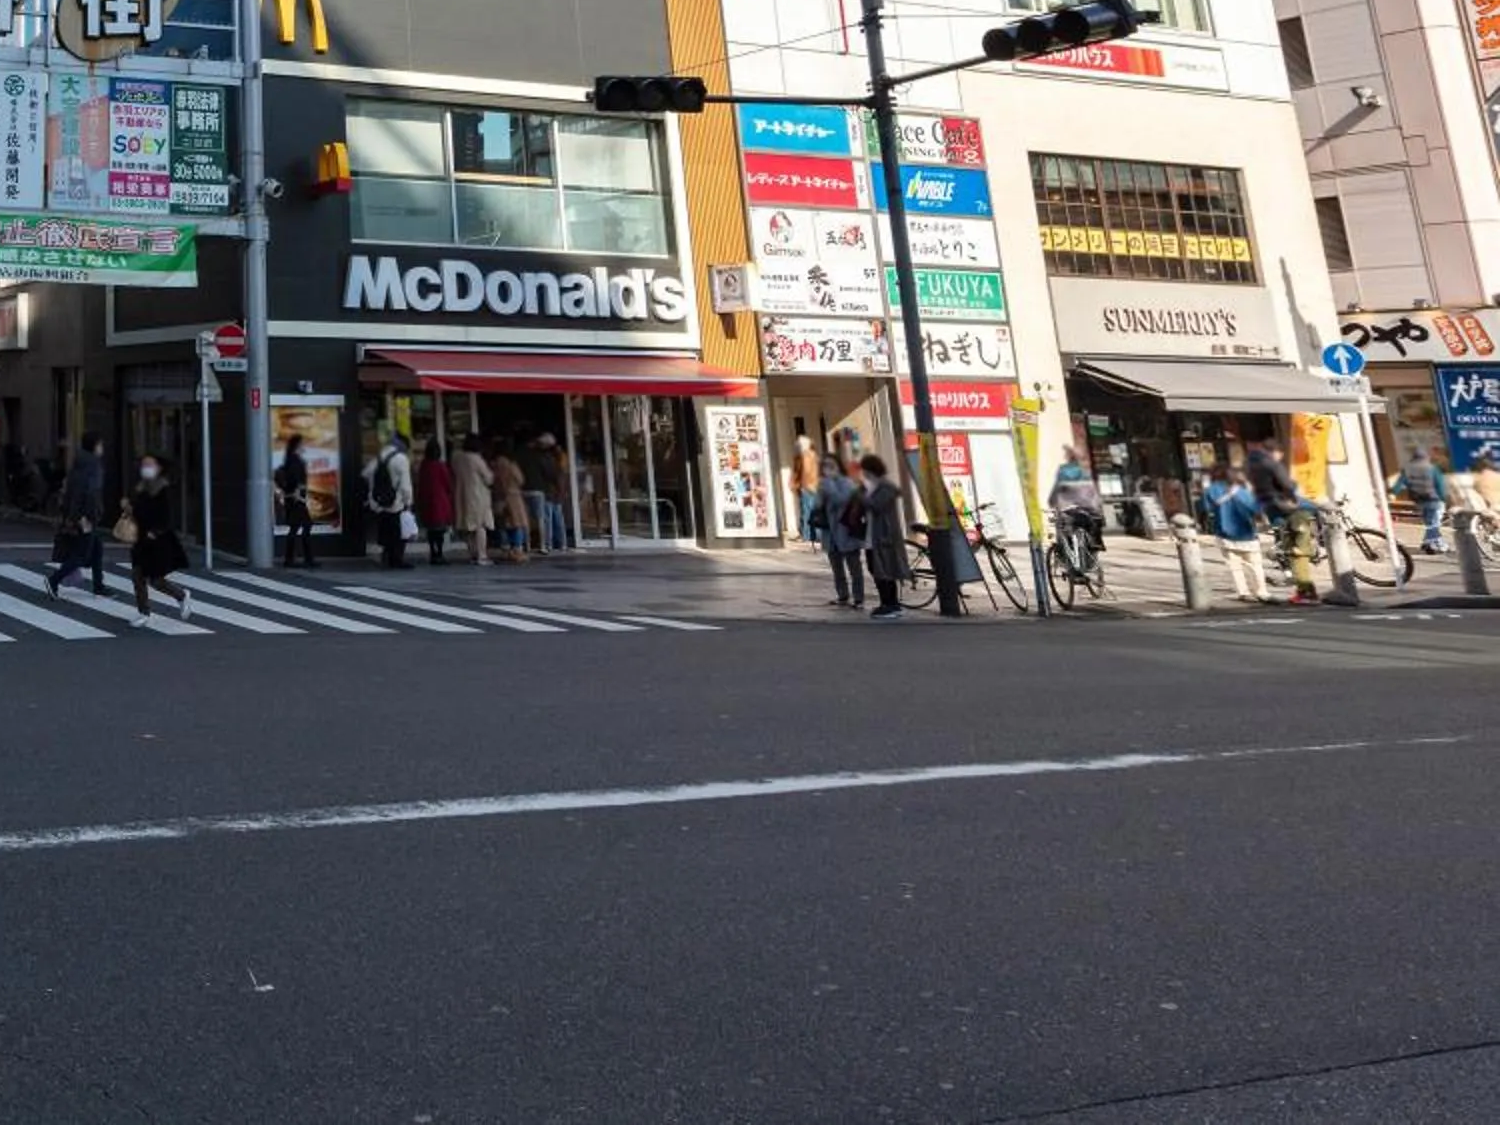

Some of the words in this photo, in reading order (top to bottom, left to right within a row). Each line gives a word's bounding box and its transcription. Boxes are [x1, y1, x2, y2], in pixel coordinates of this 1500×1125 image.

[753, 118, 837, 138] アートネイチャー
[0, 248, 127, 268] 感染させない
[343, 256, 690, 322] McDonald's
[914, 273, 995, 299] FUKUYA
[1103, 305, 1237, 337] SUNMERRY'S
[921, 330, 1002, 370] ねぎし
